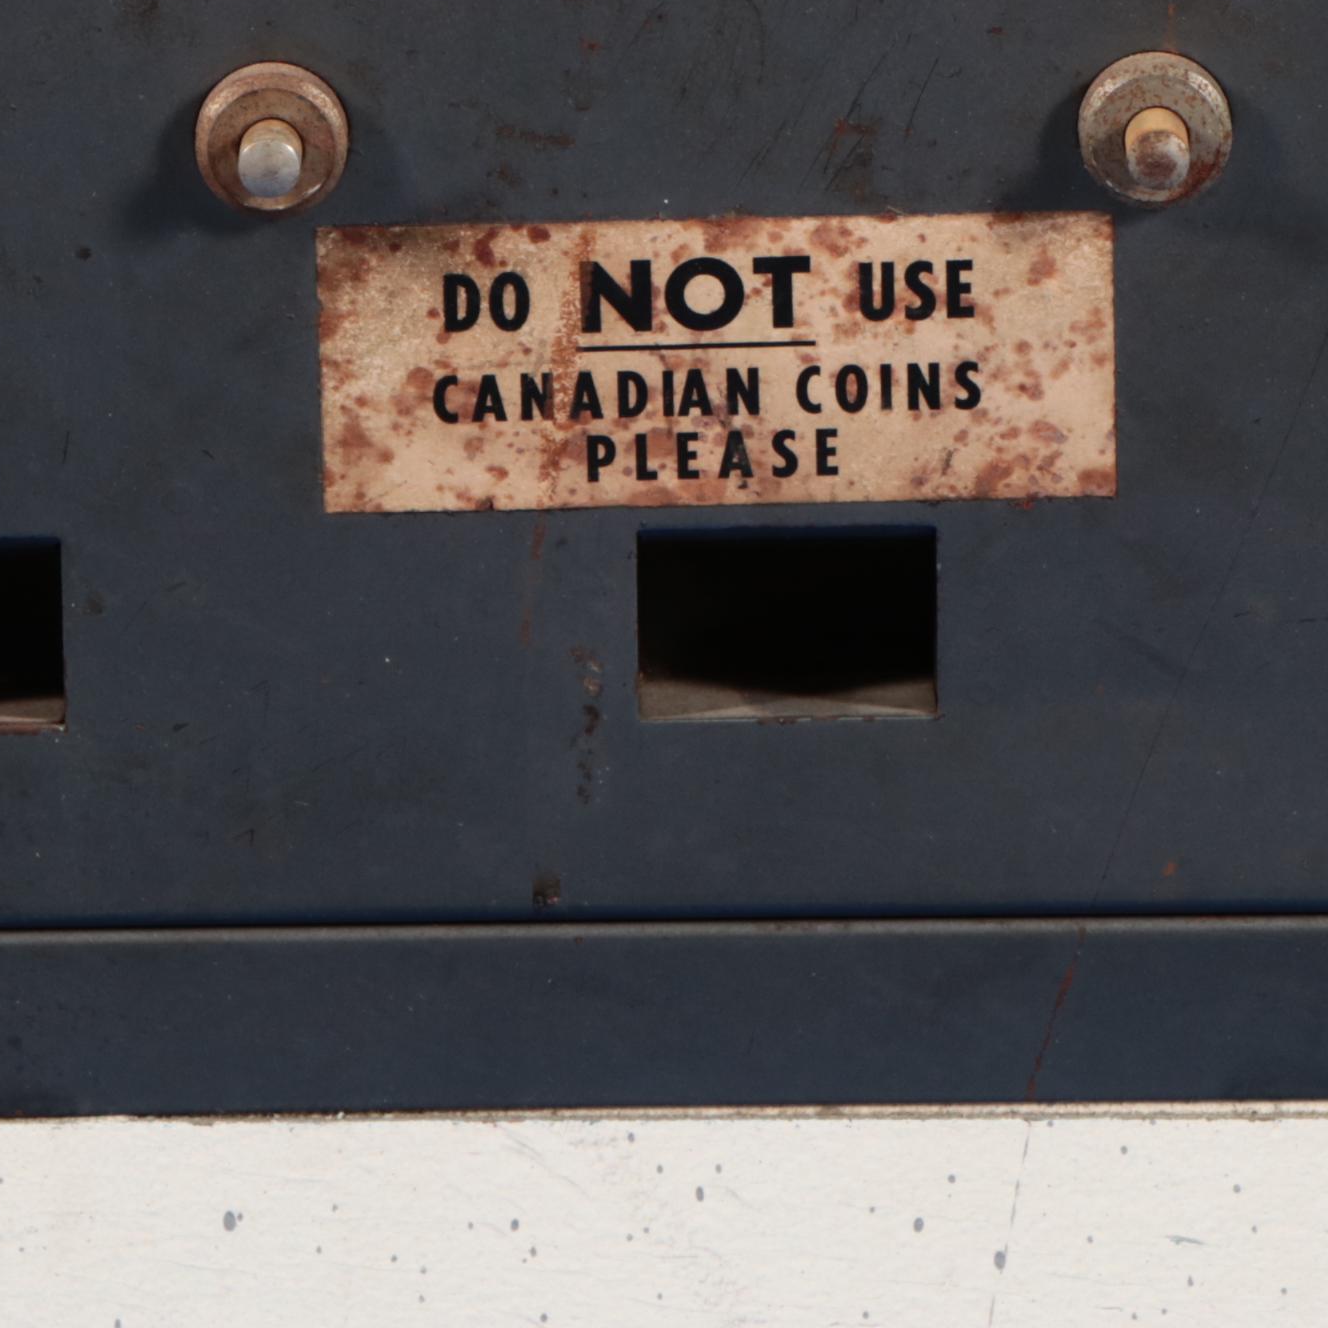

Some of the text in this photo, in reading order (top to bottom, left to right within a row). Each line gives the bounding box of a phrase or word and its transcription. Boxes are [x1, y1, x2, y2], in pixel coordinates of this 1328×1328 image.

[442, 255, 976, 333] DO NOT USE
[432, 360, 982, 423] CANADIAN COINS
[586, 427, 840, 482] PLEASE
